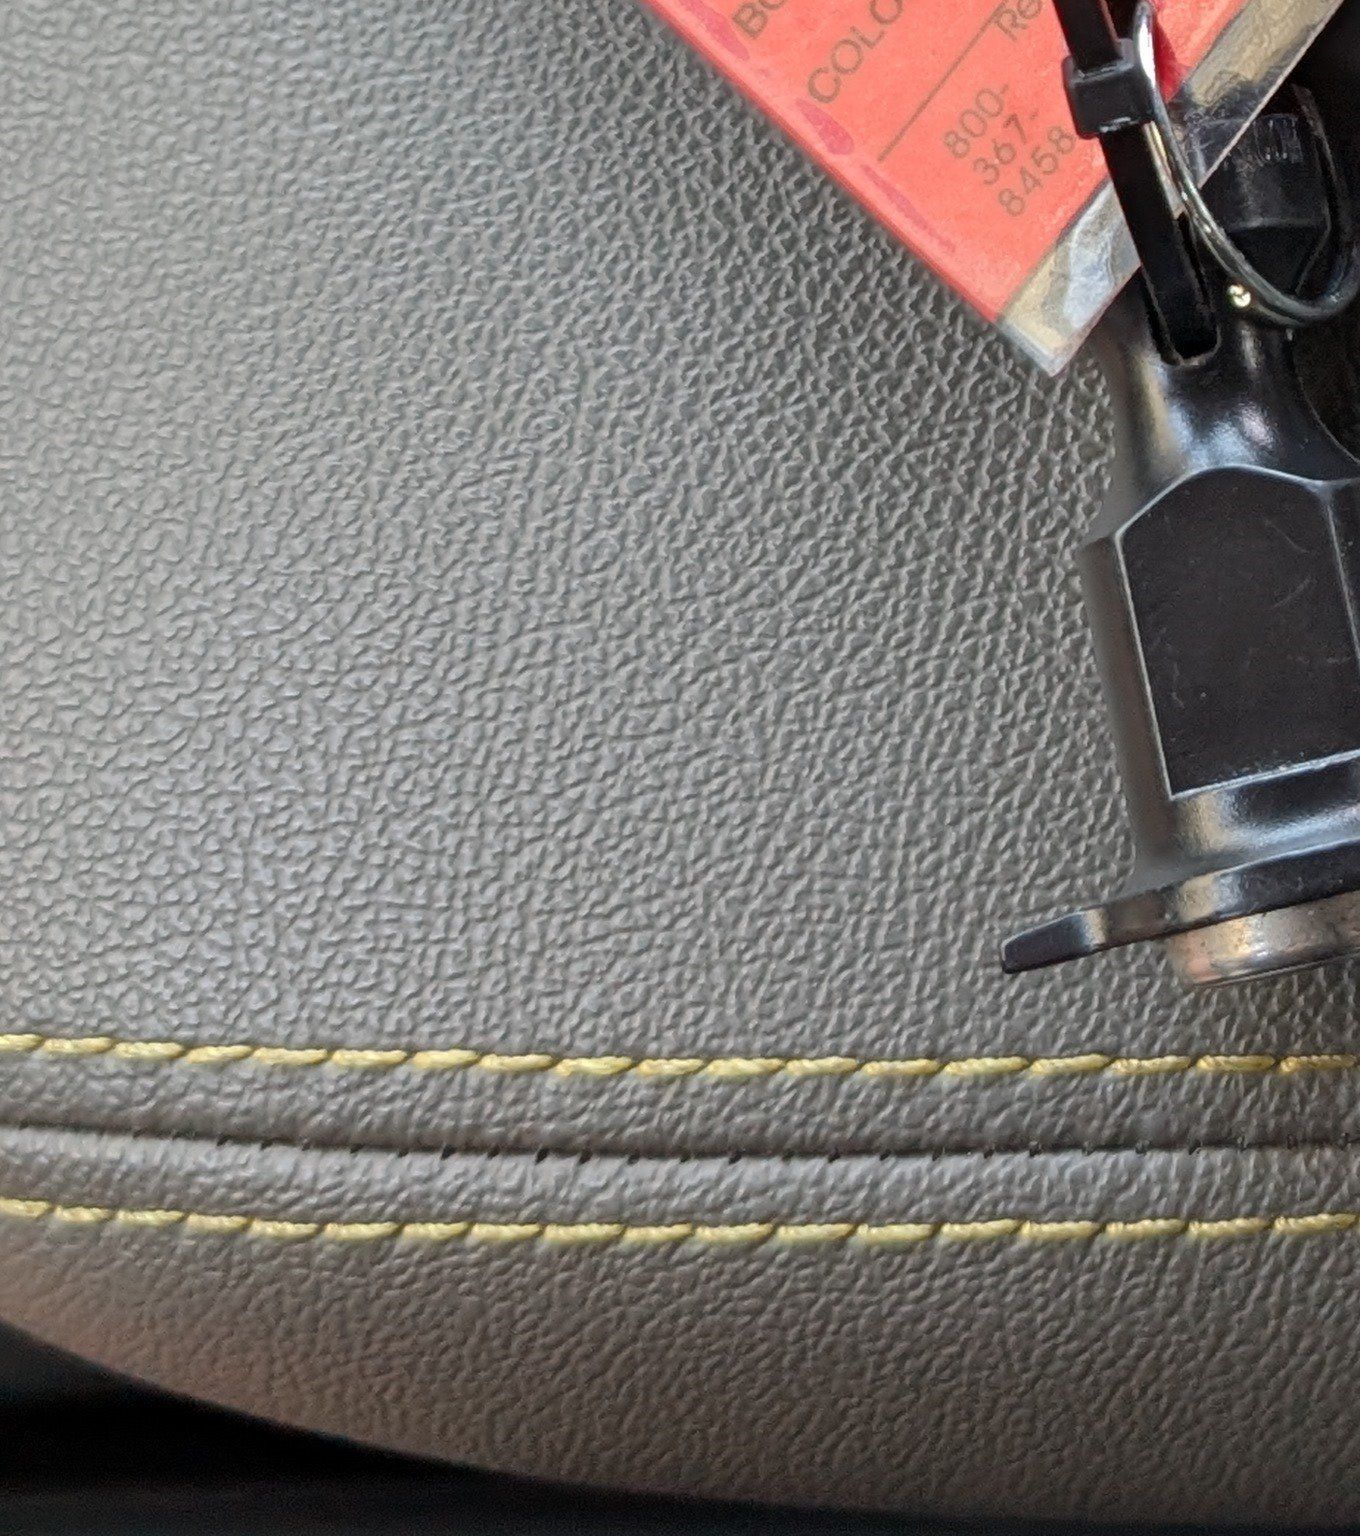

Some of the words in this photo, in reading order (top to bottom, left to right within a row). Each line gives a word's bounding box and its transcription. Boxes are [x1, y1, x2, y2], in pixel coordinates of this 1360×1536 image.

[942, 83, 1009, 161] 800-
[972, 109, 1039, 186] 367-
[997, 126, 1076, 218] 8458
